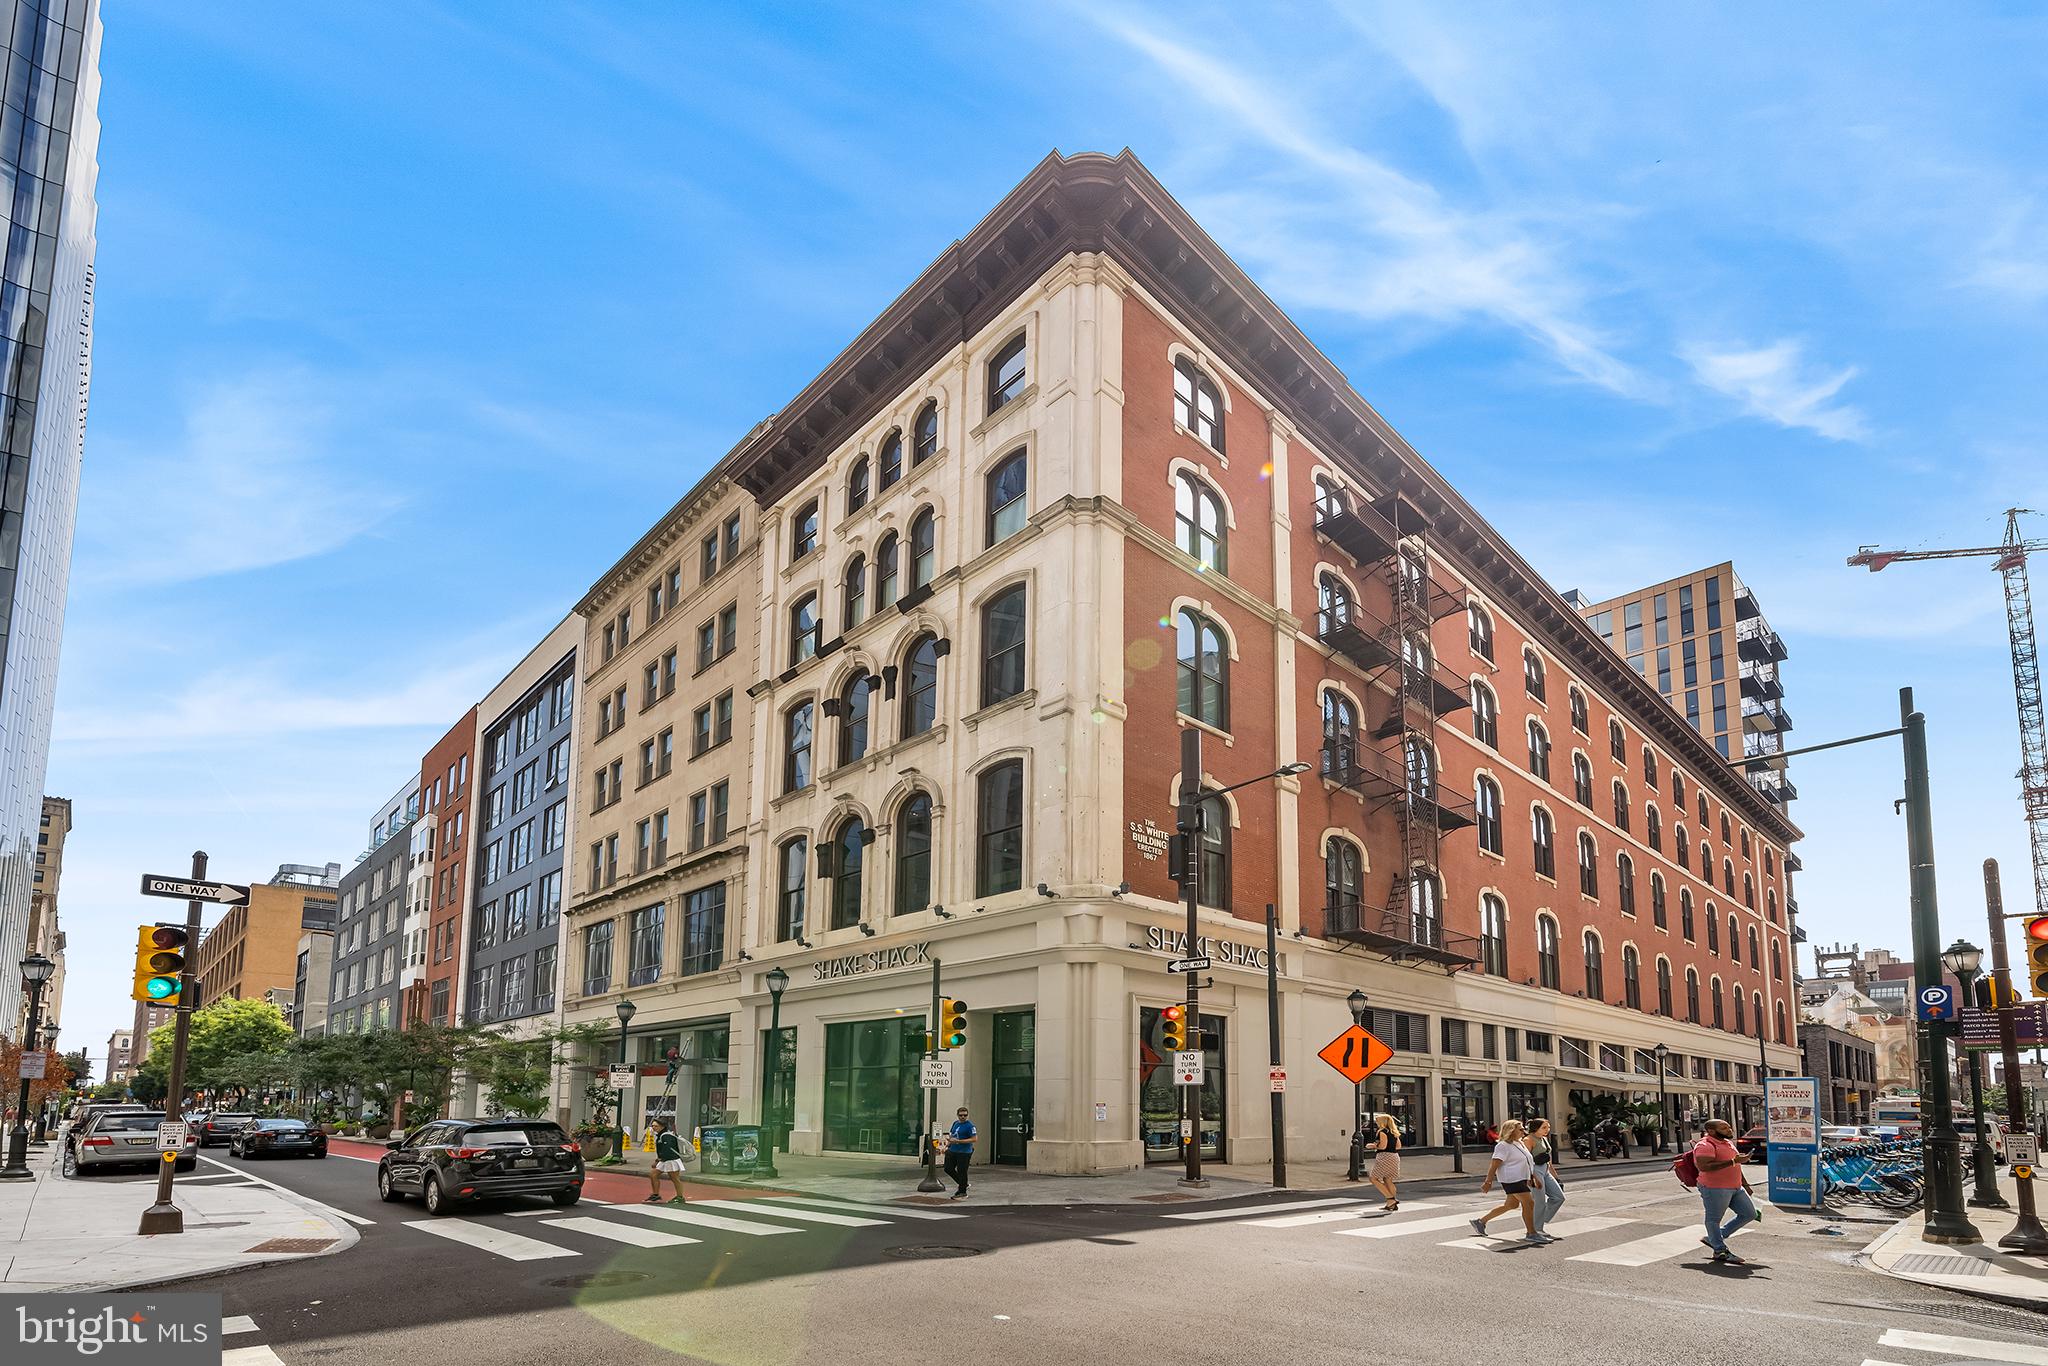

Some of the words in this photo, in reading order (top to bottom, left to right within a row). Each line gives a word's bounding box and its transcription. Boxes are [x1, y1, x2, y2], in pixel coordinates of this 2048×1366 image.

[1144, 818, 1156, 828] THE
[1129, 821, 1145, 834] S.S.
[1146, 826, 1170, 841] WHITE
[1132, 832, 1168, 850] BUILDING
[1137, 842, 1163, 856] ERECTED
[154, 882, 184, 893] ONE
[189, 886, 220, 896] WAY
[812, 954, 865, 981] SHAKE
[867, 941, 931, 972] SHACK
[1179, 962, 1190, 970] ONE
[1193, 960, 1207, 968] WAY
[1927, 991, 1941, 1001] P
